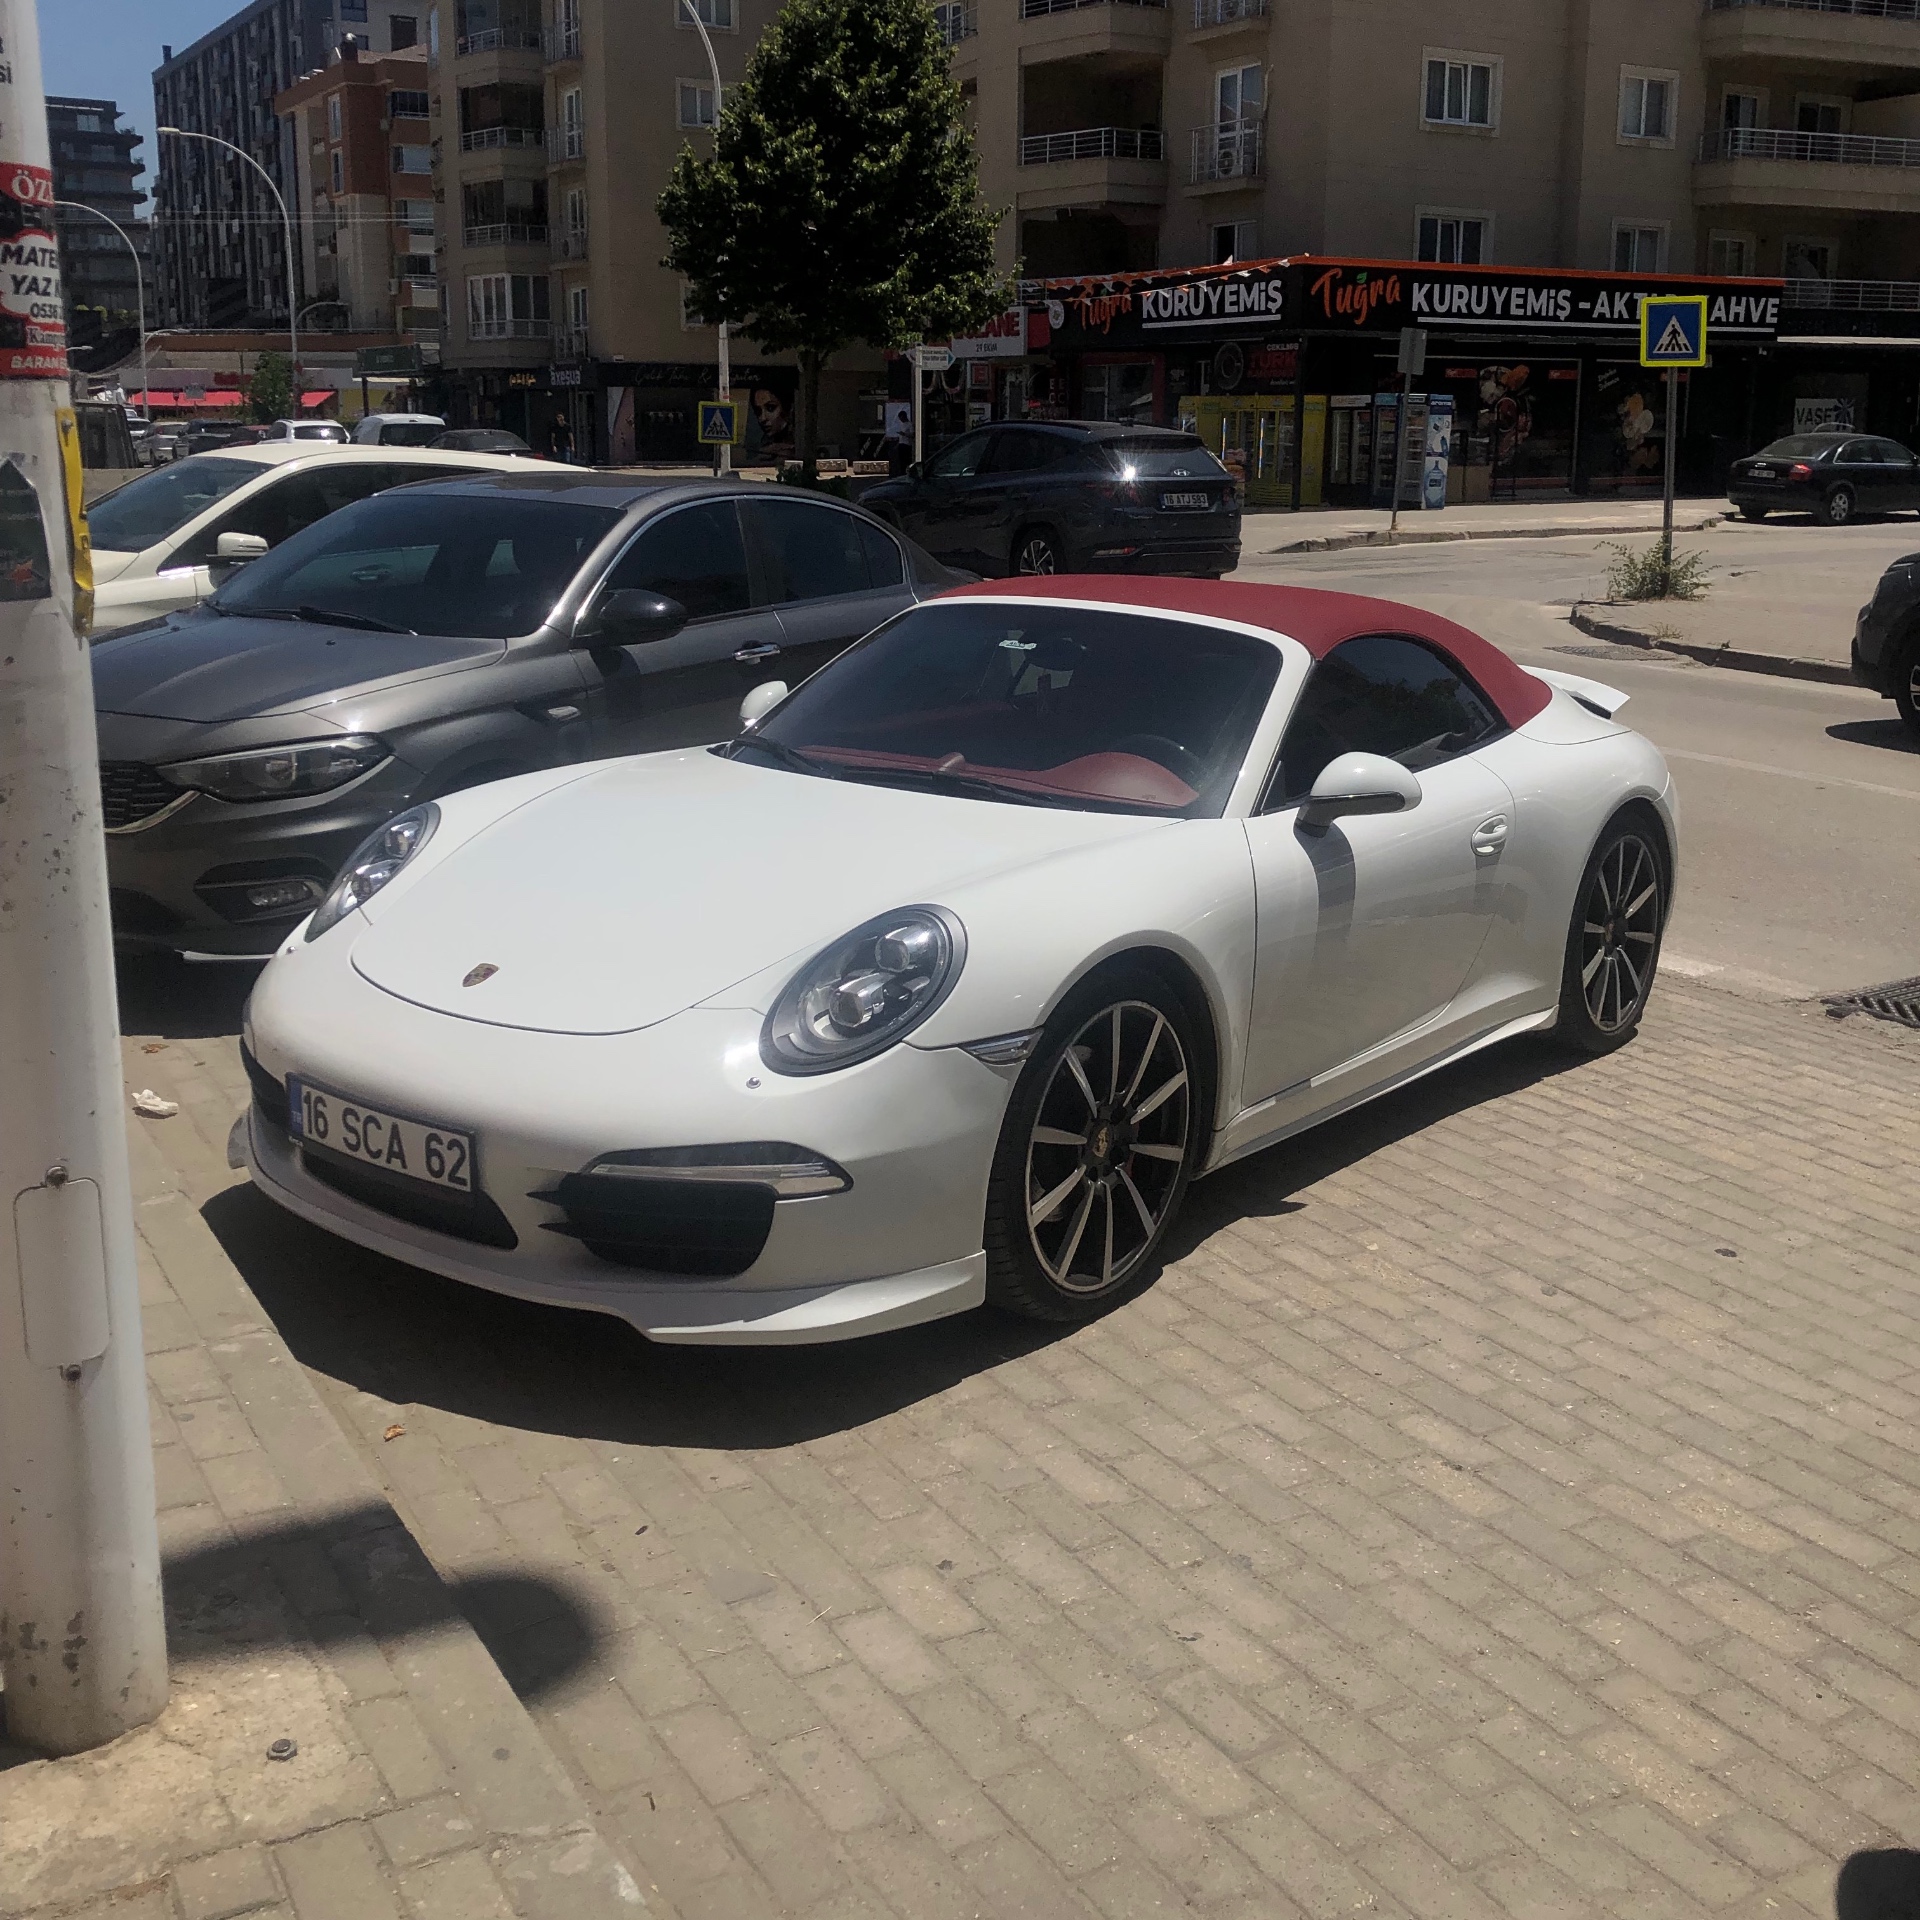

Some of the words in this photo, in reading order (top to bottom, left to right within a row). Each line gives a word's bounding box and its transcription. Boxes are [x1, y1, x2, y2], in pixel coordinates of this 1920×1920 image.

[10, 274, 52, 297] YAZ
[1142, 280, 1282, 319] KURUYEMİŞ
[1311, 268, 1400, 325] Tuğra
[1411, 283, 1572, 321] KURUYEMİŞ
[1706, 295, 1780, 324] AHVE
[1165, 494, 1174, 505] 16
[1176, 494, 1191, 505] ATJ
[303, 1091, 329, 1139] 16
[342, 1107, 408, 1170] SCA
[425, 1132, 468, 1187] 62
